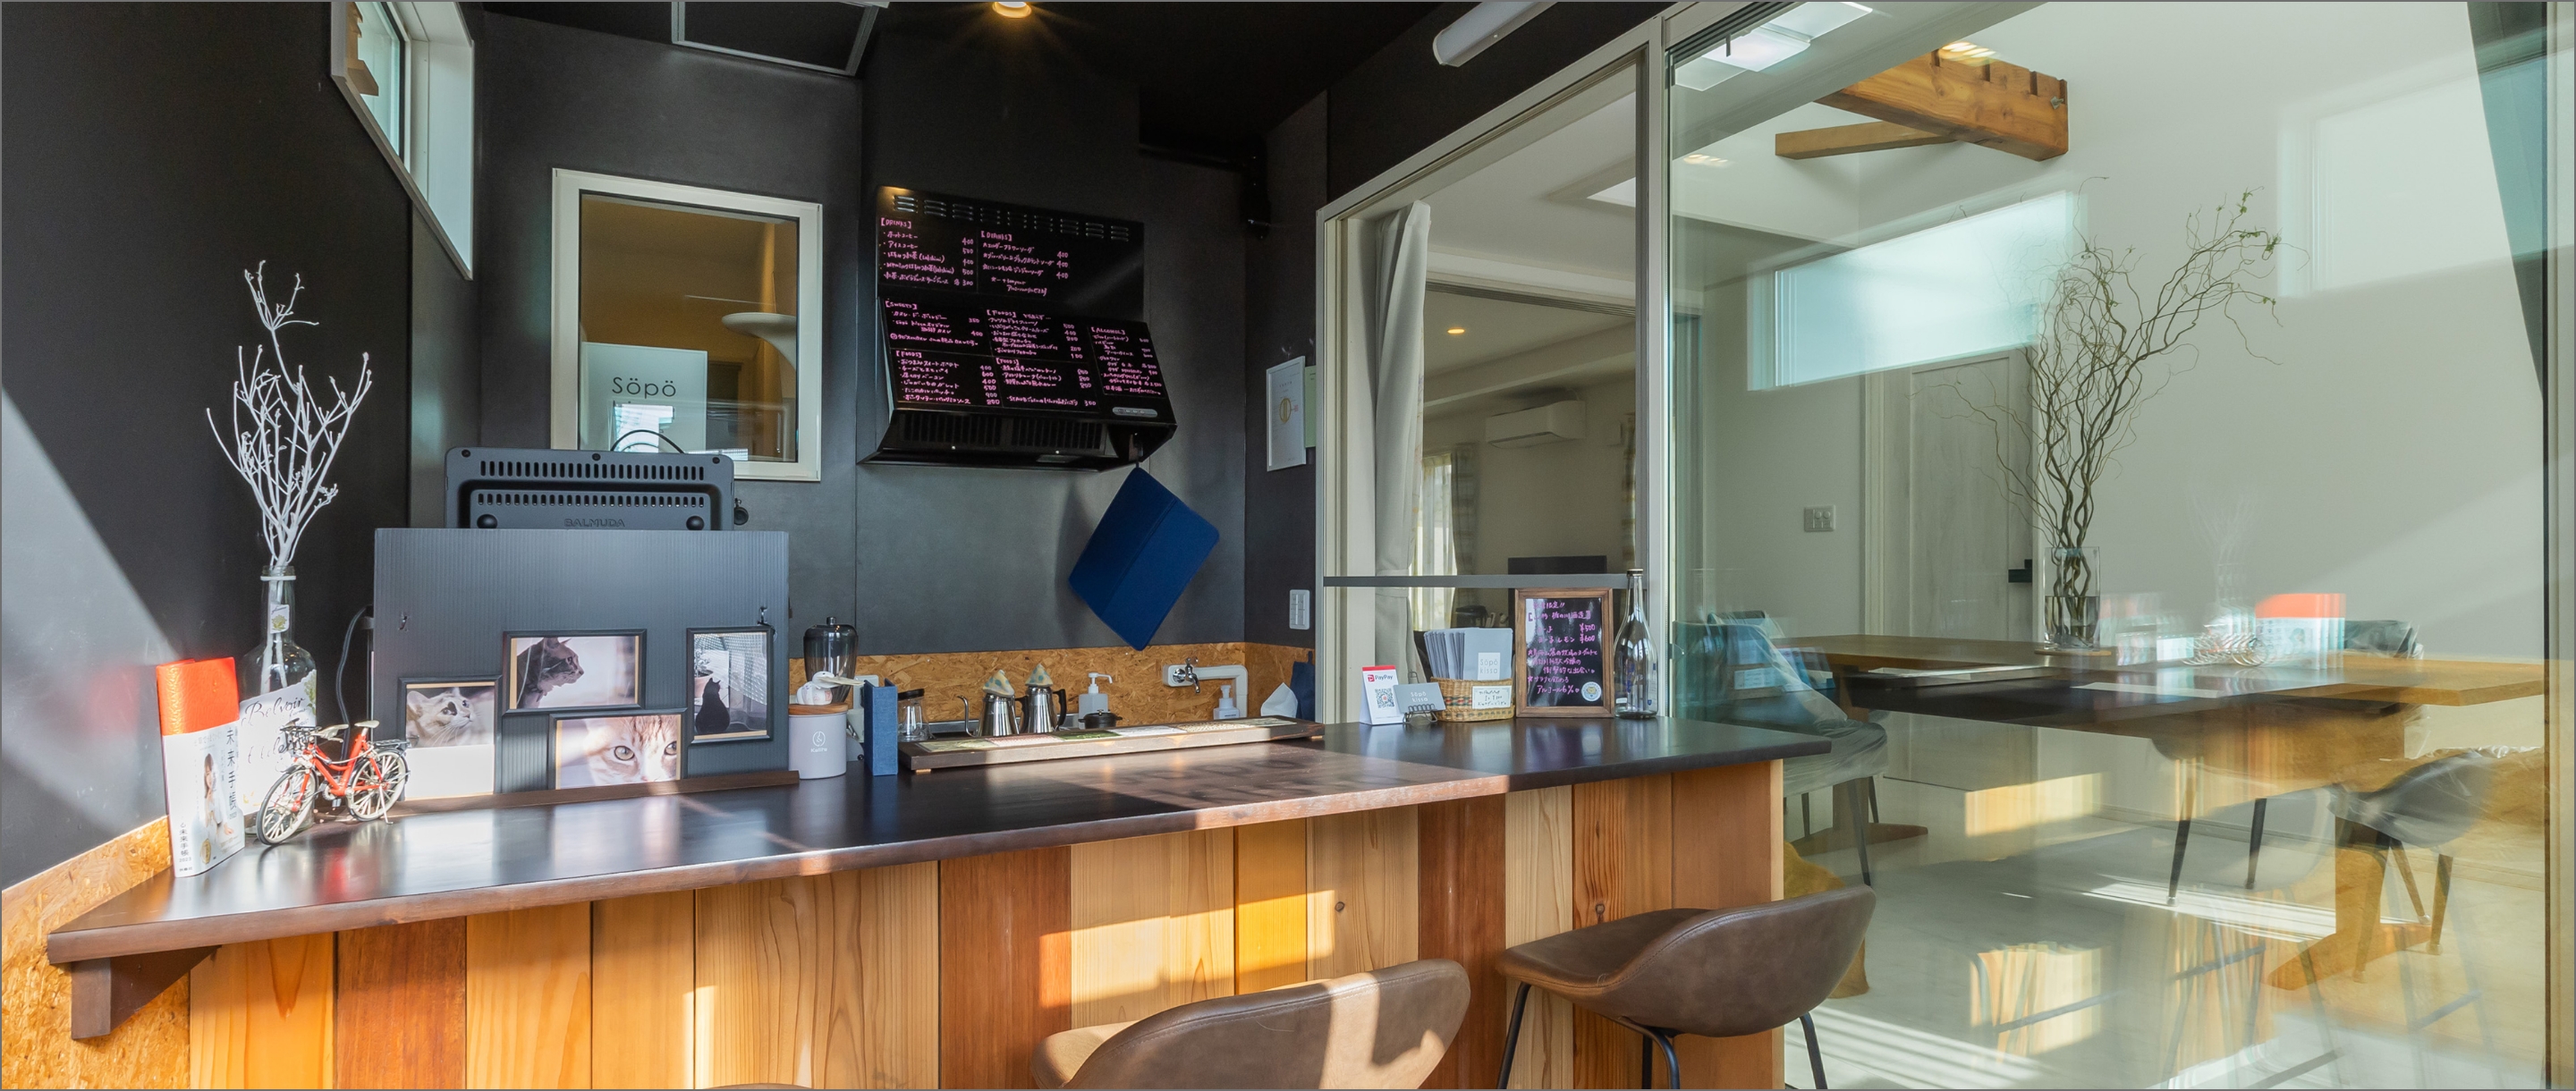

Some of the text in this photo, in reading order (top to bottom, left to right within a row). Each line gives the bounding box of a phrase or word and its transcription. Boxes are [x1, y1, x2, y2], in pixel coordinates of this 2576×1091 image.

[962, 237, 974, 246] 400
[1056, 260, 1069, 268] 400
[612, 376, 676, 399] Söpö
[564, 518, 625, 528] BALMUDA
[1580, 622, 1596, 633] ¥500
[1580, 633, 1596, 644] ¥600
[1479, 666, 1498, 674] kissa
[244, 697, 305, 726] Belvoir
